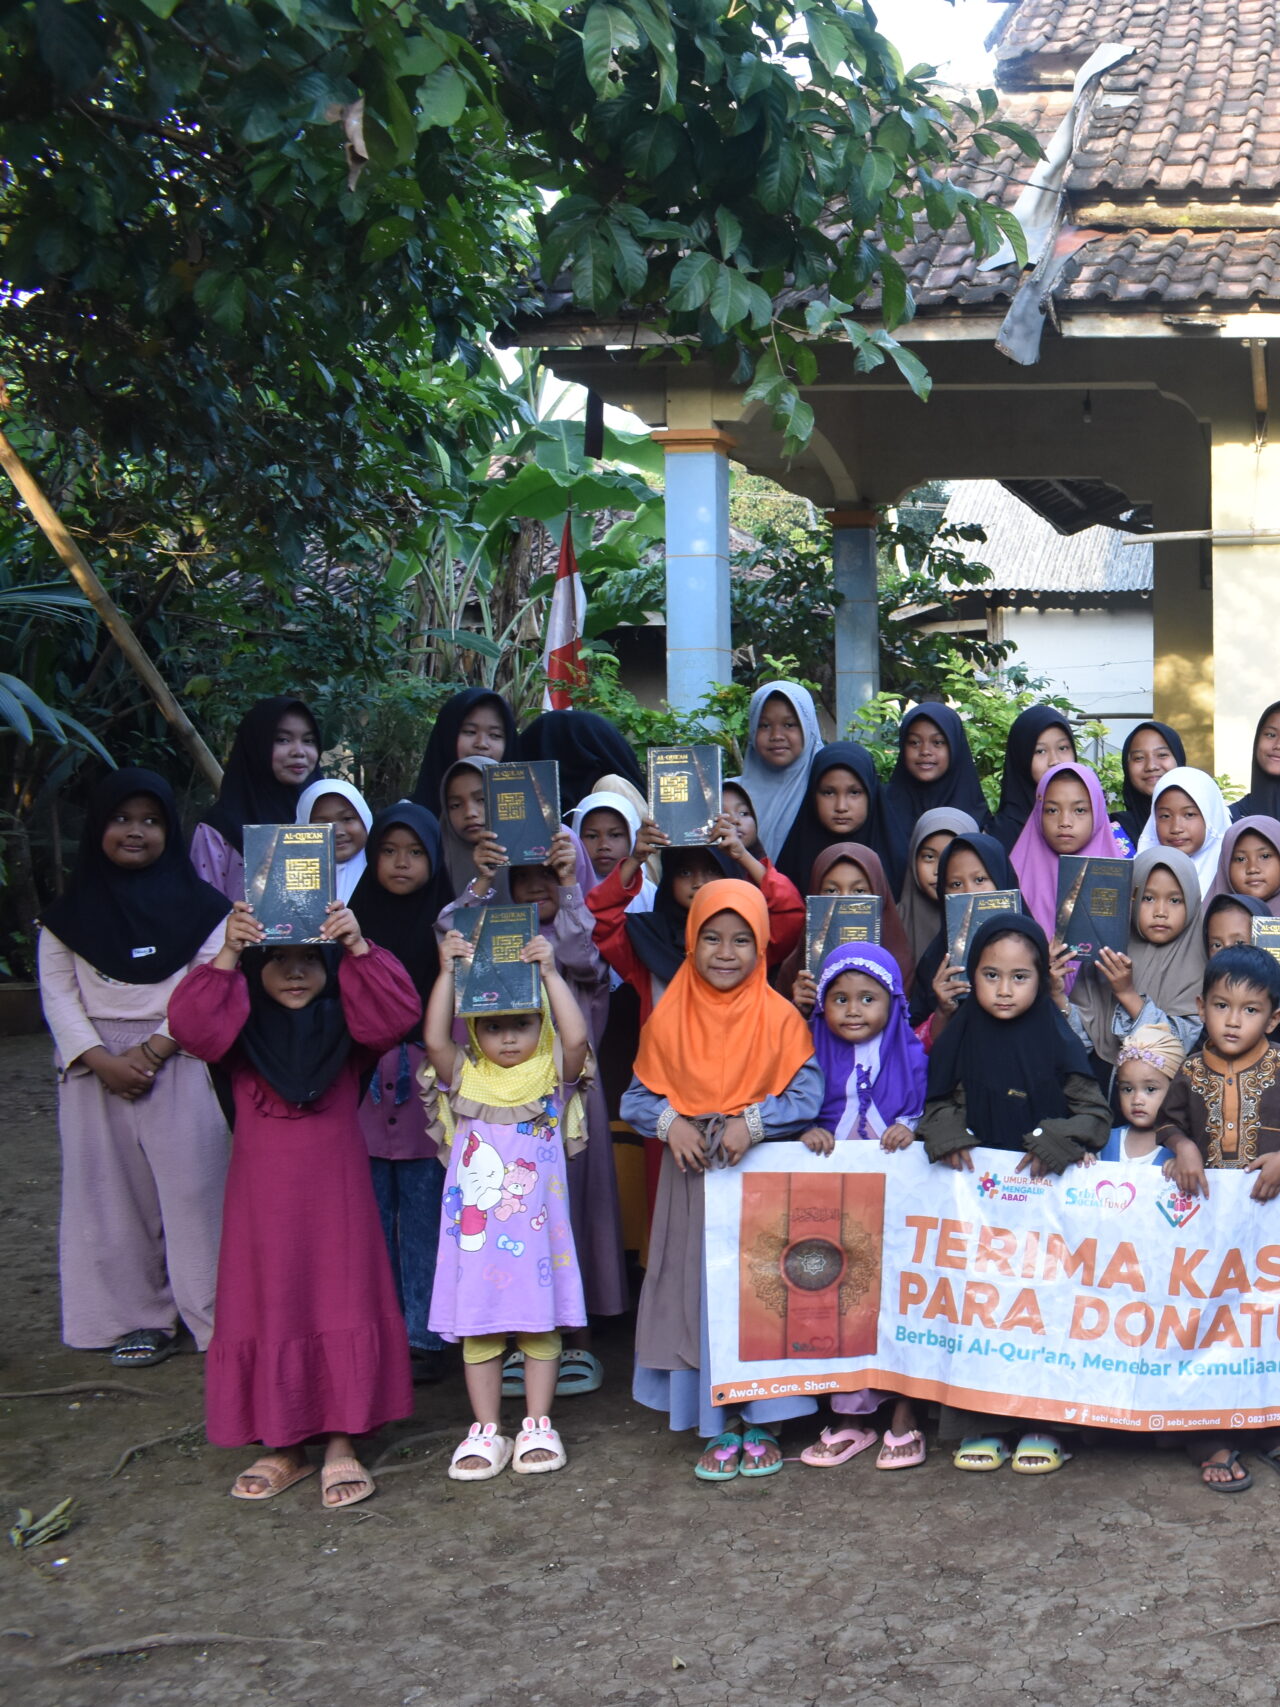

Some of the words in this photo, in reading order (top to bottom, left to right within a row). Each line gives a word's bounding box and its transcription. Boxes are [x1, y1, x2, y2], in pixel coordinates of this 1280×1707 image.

[1003, 1175, 1028, 1184] UMUR
[1001, 1193, 1028, 1202] ABADI
[905, 1215, 1146, 1292] TERIMA
[899, 1271, 1047, 1335] PARA
[895, 1325, 963, 1353] Berbagi
[968, 1338, 1076, 1370] Al-Qur'an,
[1083, 1352, 1171, 1376] Menebar
[729, 1388, 768, 1399] Aware.
[770, 1384, 801, 1394] Care.
[804, 1380, 840, 1391] Share.
